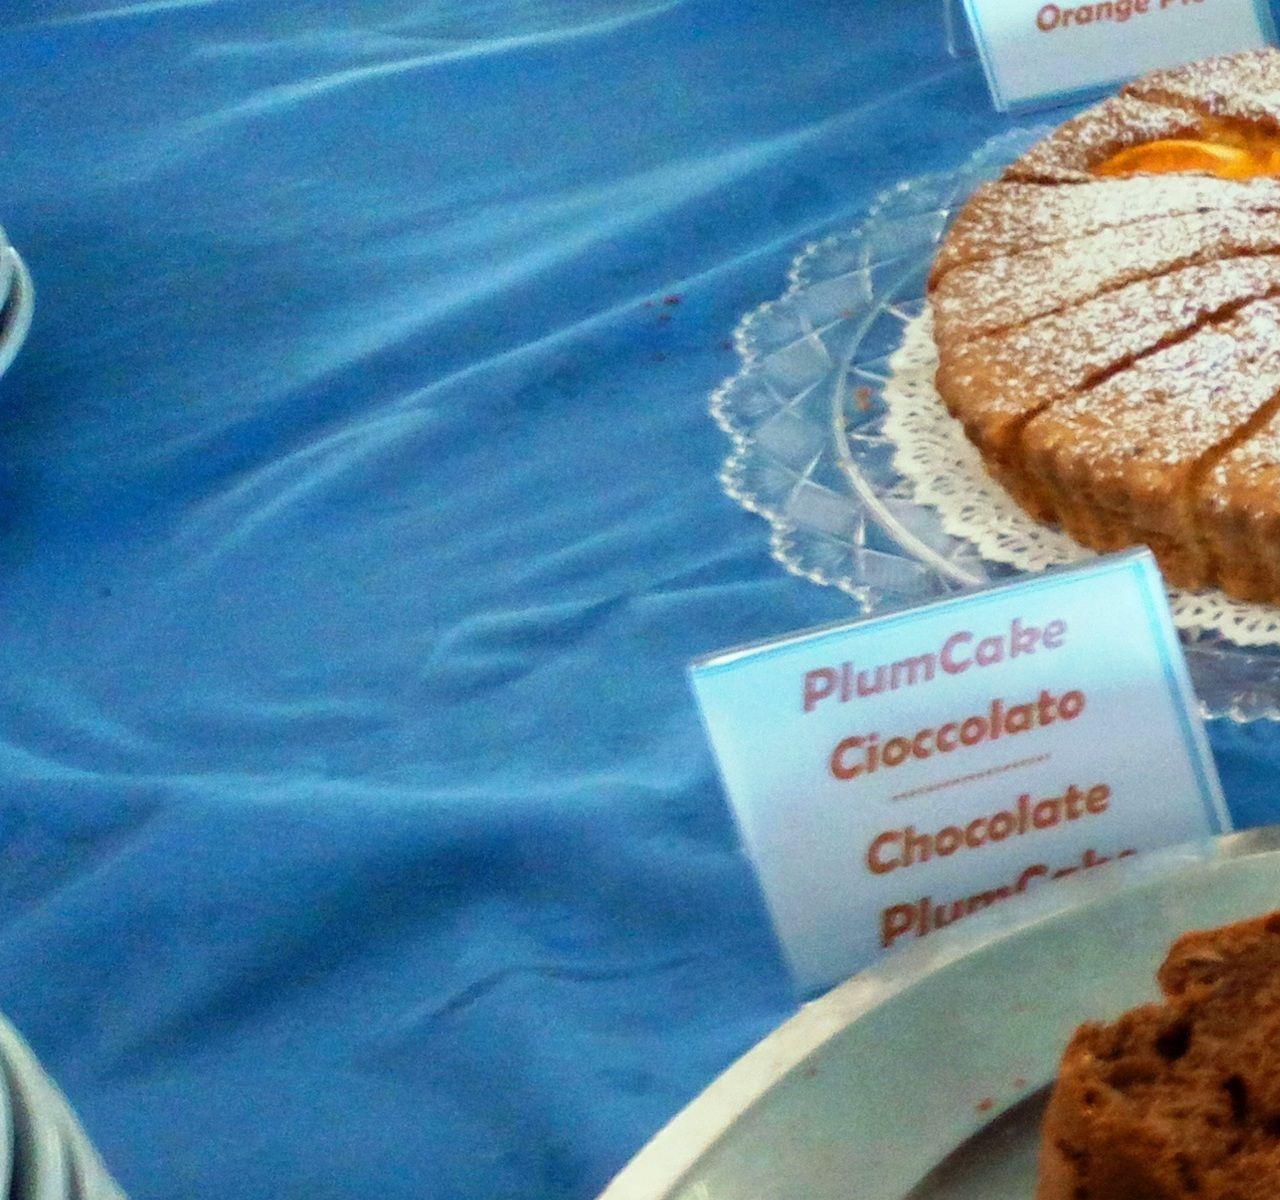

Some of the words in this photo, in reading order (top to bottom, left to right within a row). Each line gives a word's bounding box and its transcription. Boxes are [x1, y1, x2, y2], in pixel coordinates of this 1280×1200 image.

[1036, 0, 1149, 32] Orange
[802, 617, 1069, 712] PlumCake
[829, 689, 1086, 780] Cioccolato
[865, 783, 1112, 875] Chocolate
